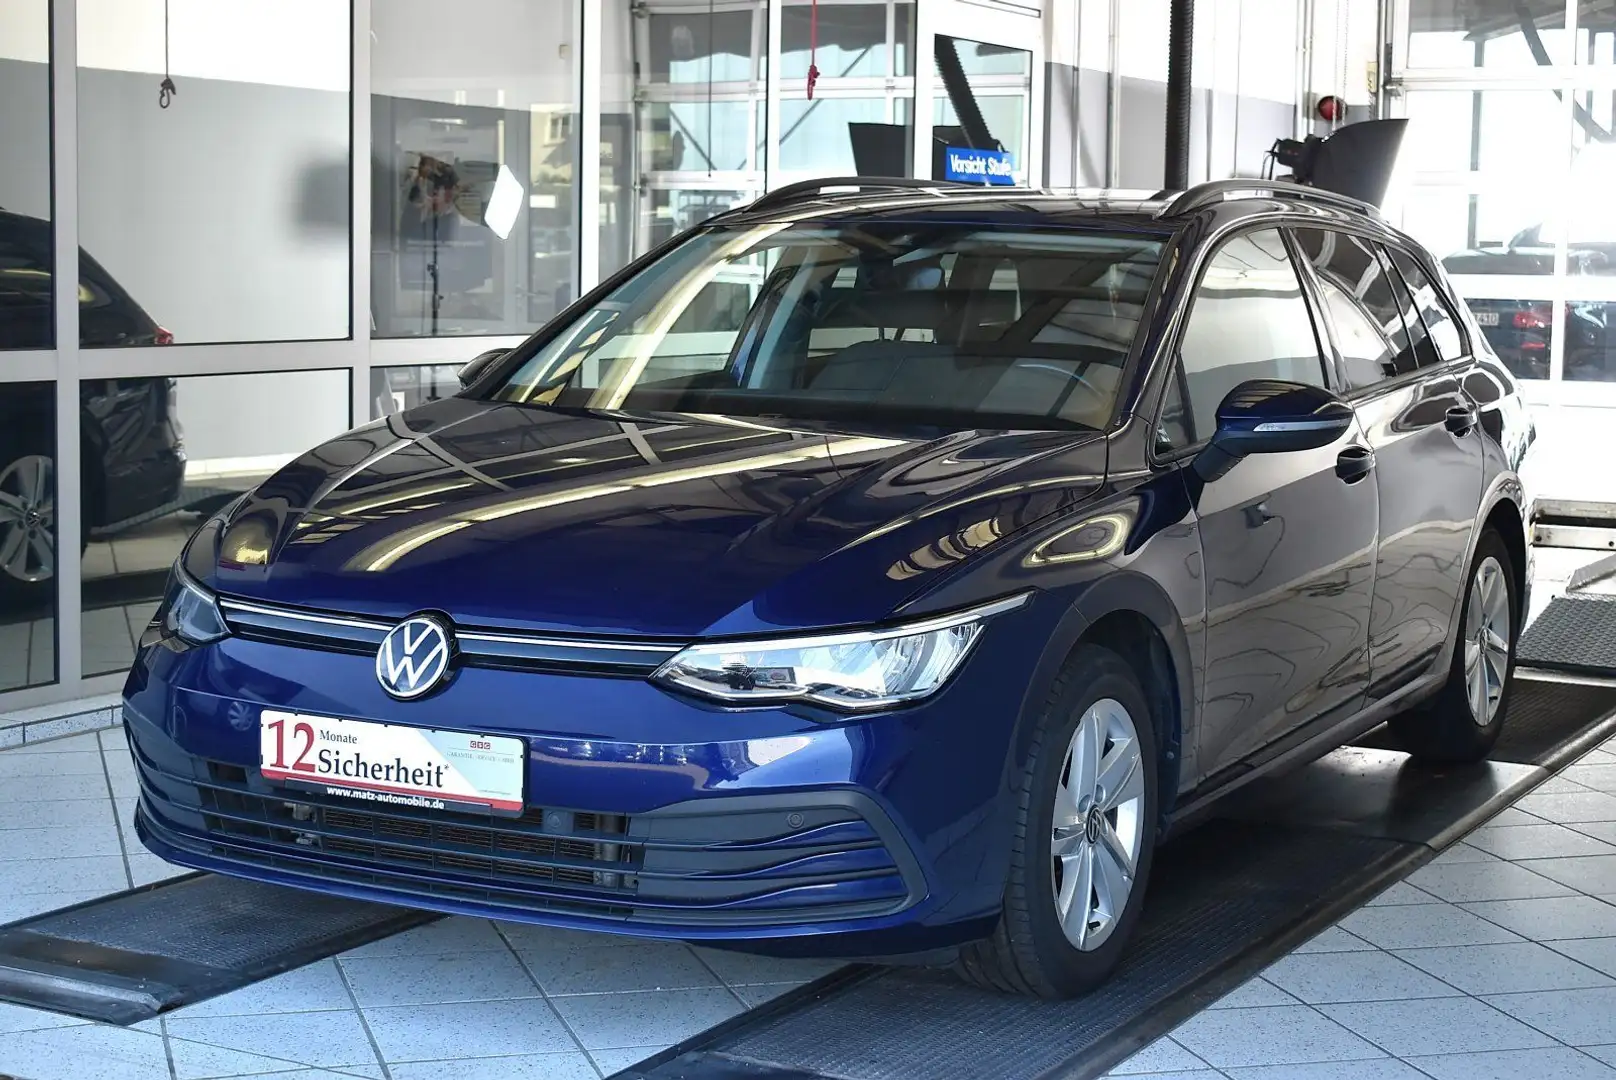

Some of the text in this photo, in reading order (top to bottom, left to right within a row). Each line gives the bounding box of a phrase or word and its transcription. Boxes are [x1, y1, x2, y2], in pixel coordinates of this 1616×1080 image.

[950, 154, 986, 175] Vorsicht
[379, 620, 446, 693] VW
[268, 719, 316, 773] 12
[319, 730, 358, 744] Monate
[327, 787, 445, 810] www.matz-automobile.de
